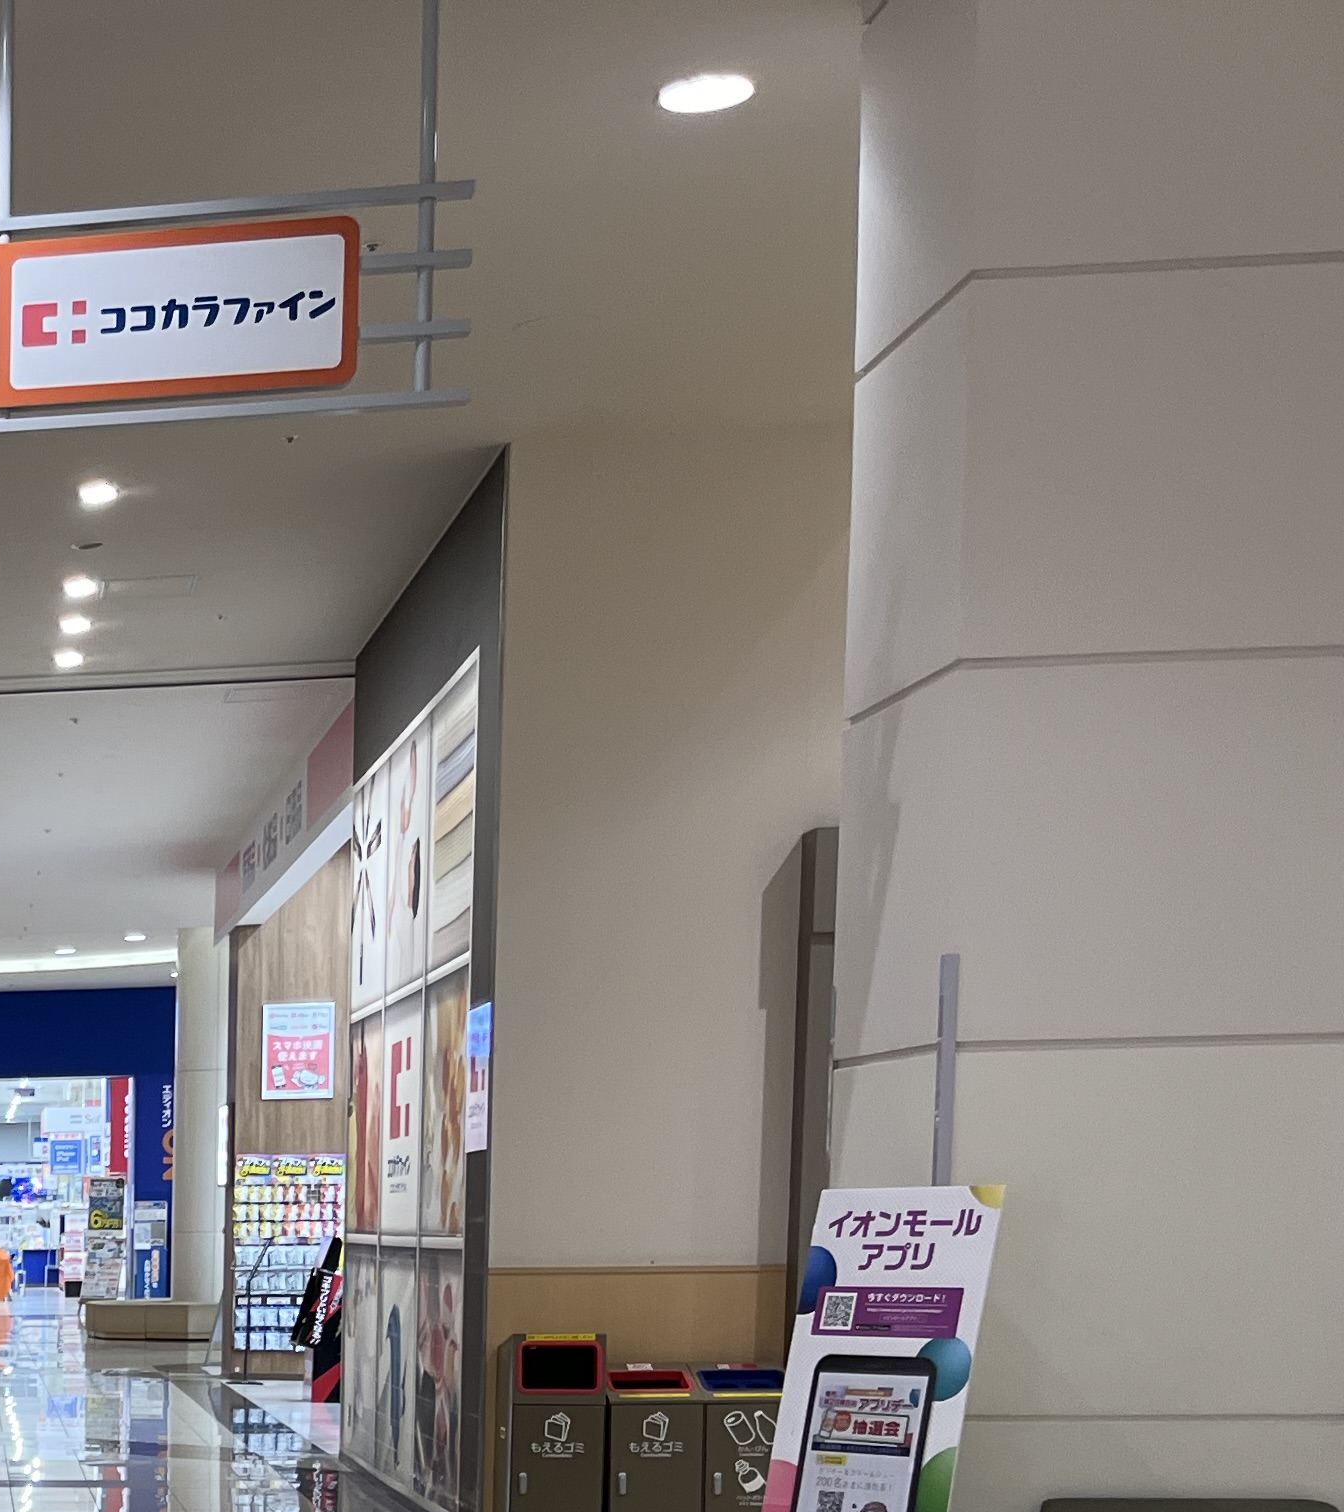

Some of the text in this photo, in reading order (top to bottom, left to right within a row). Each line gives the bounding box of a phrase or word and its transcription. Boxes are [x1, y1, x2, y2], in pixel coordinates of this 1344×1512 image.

[100, 290, 337, 335] ココカラファイン
[827, 1208, 983, 1238] イオンモール
[858, 1243, 936, 1271] アプリ
[530, 1441, 585, 1454] もえるゴミ
[629, 1441, 684, 1454] もえるゴミ
